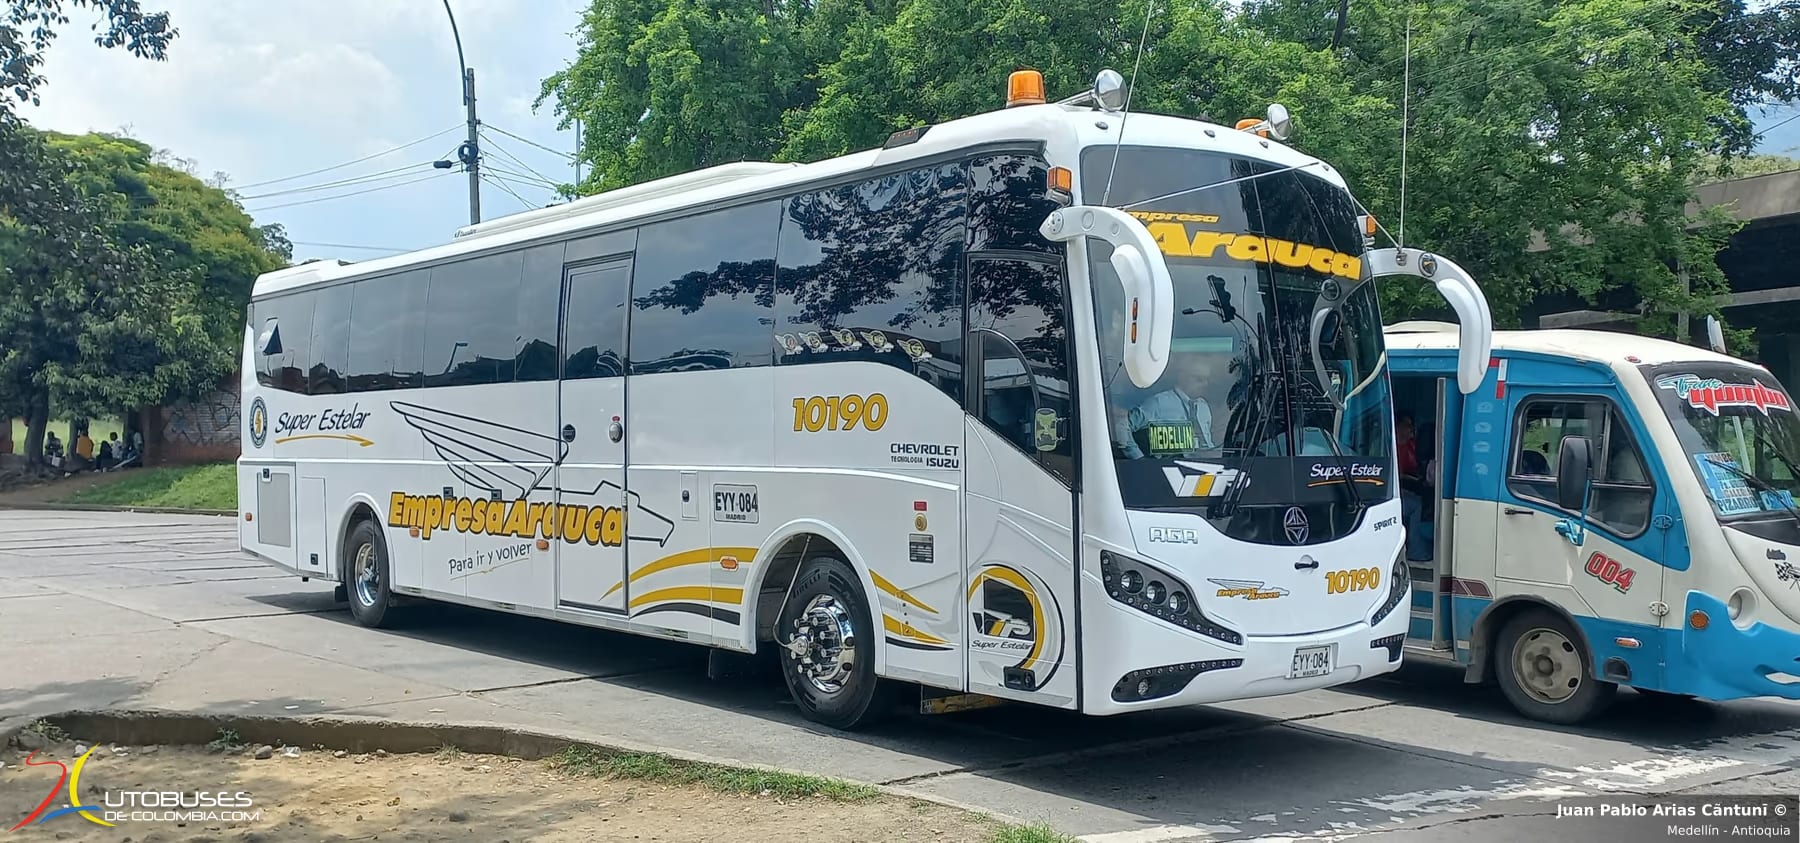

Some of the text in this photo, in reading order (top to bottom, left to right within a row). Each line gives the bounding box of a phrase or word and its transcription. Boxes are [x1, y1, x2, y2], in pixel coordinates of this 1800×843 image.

[1147, 222, 1361, 281] Arauca
[275, 412, 317, 437] Super
[318, 402, 371, 431] Estelar
[793, 393, 889, 432] 10190
[890, 443, 960, 457] CHEVROLET
[1150, 426, 1193, 450] MEDELLIN
[926, 457, 959, 469] ISUZU
[1351, 463, 1384, 477] Estelar
[449, 541, 533, 575] Para ir y volver
[1584, 550, 1637, 595] 004
[1325, 566, 1381, 595] 10190
[971, 639, 1032, 650] Super Estelar
